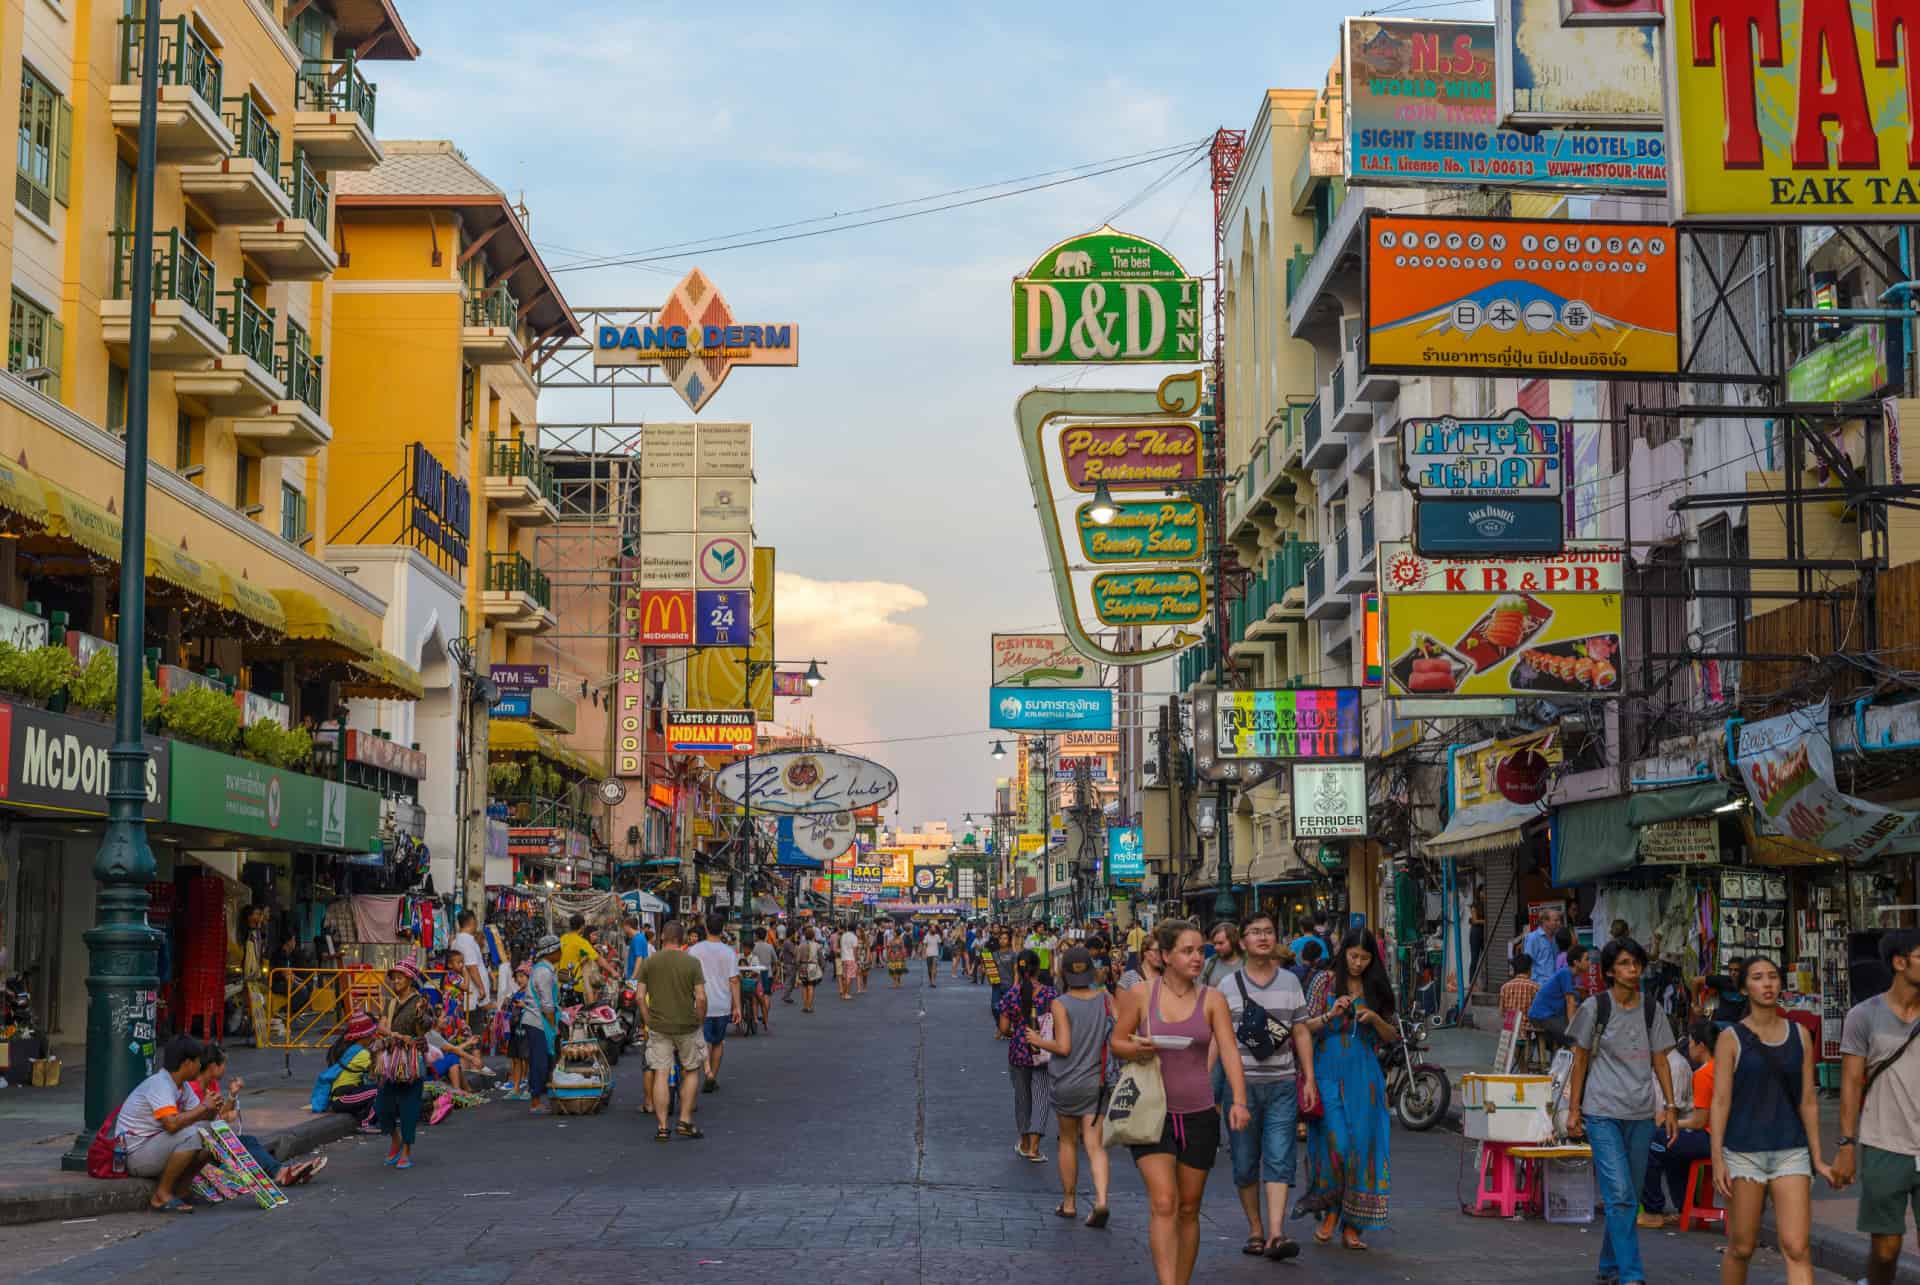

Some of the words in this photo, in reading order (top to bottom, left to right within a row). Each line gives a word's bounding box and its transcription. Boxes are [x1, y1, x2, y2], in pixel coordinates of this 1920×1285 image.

[1368, 79, 1437, 97] WORLD
[1444, 80, 1495, 99] WIDE
[1360, 128, 1415, 149] SIGHT
[1423, 130, 1488, 152] SEEING
[1496, 132, 1545, 154] TOUR
[1572, 135, 1628, 157] HOTEL
[1360, 155, 1393, 171] T.A.T.
[1397, 156, 1440, 173] License
[1443, 157, 1465, 174] No.
[1469, 159, 1534, 176] 13/00613
[1769, 177, 1853, 205] EAK
[1382, 232, 1506, 249] NIPPON
[1524, 236, 1664, 252] ICHIBAN
[1112, 255, 1129, 268] The
[1130, 255, 1151, 268] best
[1397, 257, 1501, 268] JAPANESE
[1515, 260, 1646, 272] RESTAURANT
[1021, 282, 1166, 361] D&D
[1175, 283, 1197, 353] INN
[1456, 305, 1589, 328] 日本一番
[599, 325, 688, 349] DANG
[702, 325, 791, 349] DERM
[1066, 429, 1195, 457] Pick-Thai
[1083, 459, 1182, 481] Restaurant
[1092, 531, 1144, 557] Beauty
[1146, 530, 1192, 553] Salon
[711, 609, 736, 627] 24
[1102, 599, 1160, 619] Shopping
[995, 638, 1055, 651] CENTER
[491, 671, 519, 683] ATM
[672, 714, 704, 724] TASTE
[705, 714, 720, 724] OF
[721, 714, 750, 724] INDIA
[621, 696, 639, 772] FOOD
[669, 726, 716, 742] INDIAN
[718, 726, 753, 742] FOOD
[1066, 734, 1093, 745] SIAM
[736, 766, 788, 801] The
[1299, 815, 1364, 827] FERRIDER
[1300, 826, 1338, 835] TATTOO
[853, 866, 881, 877] BAG
